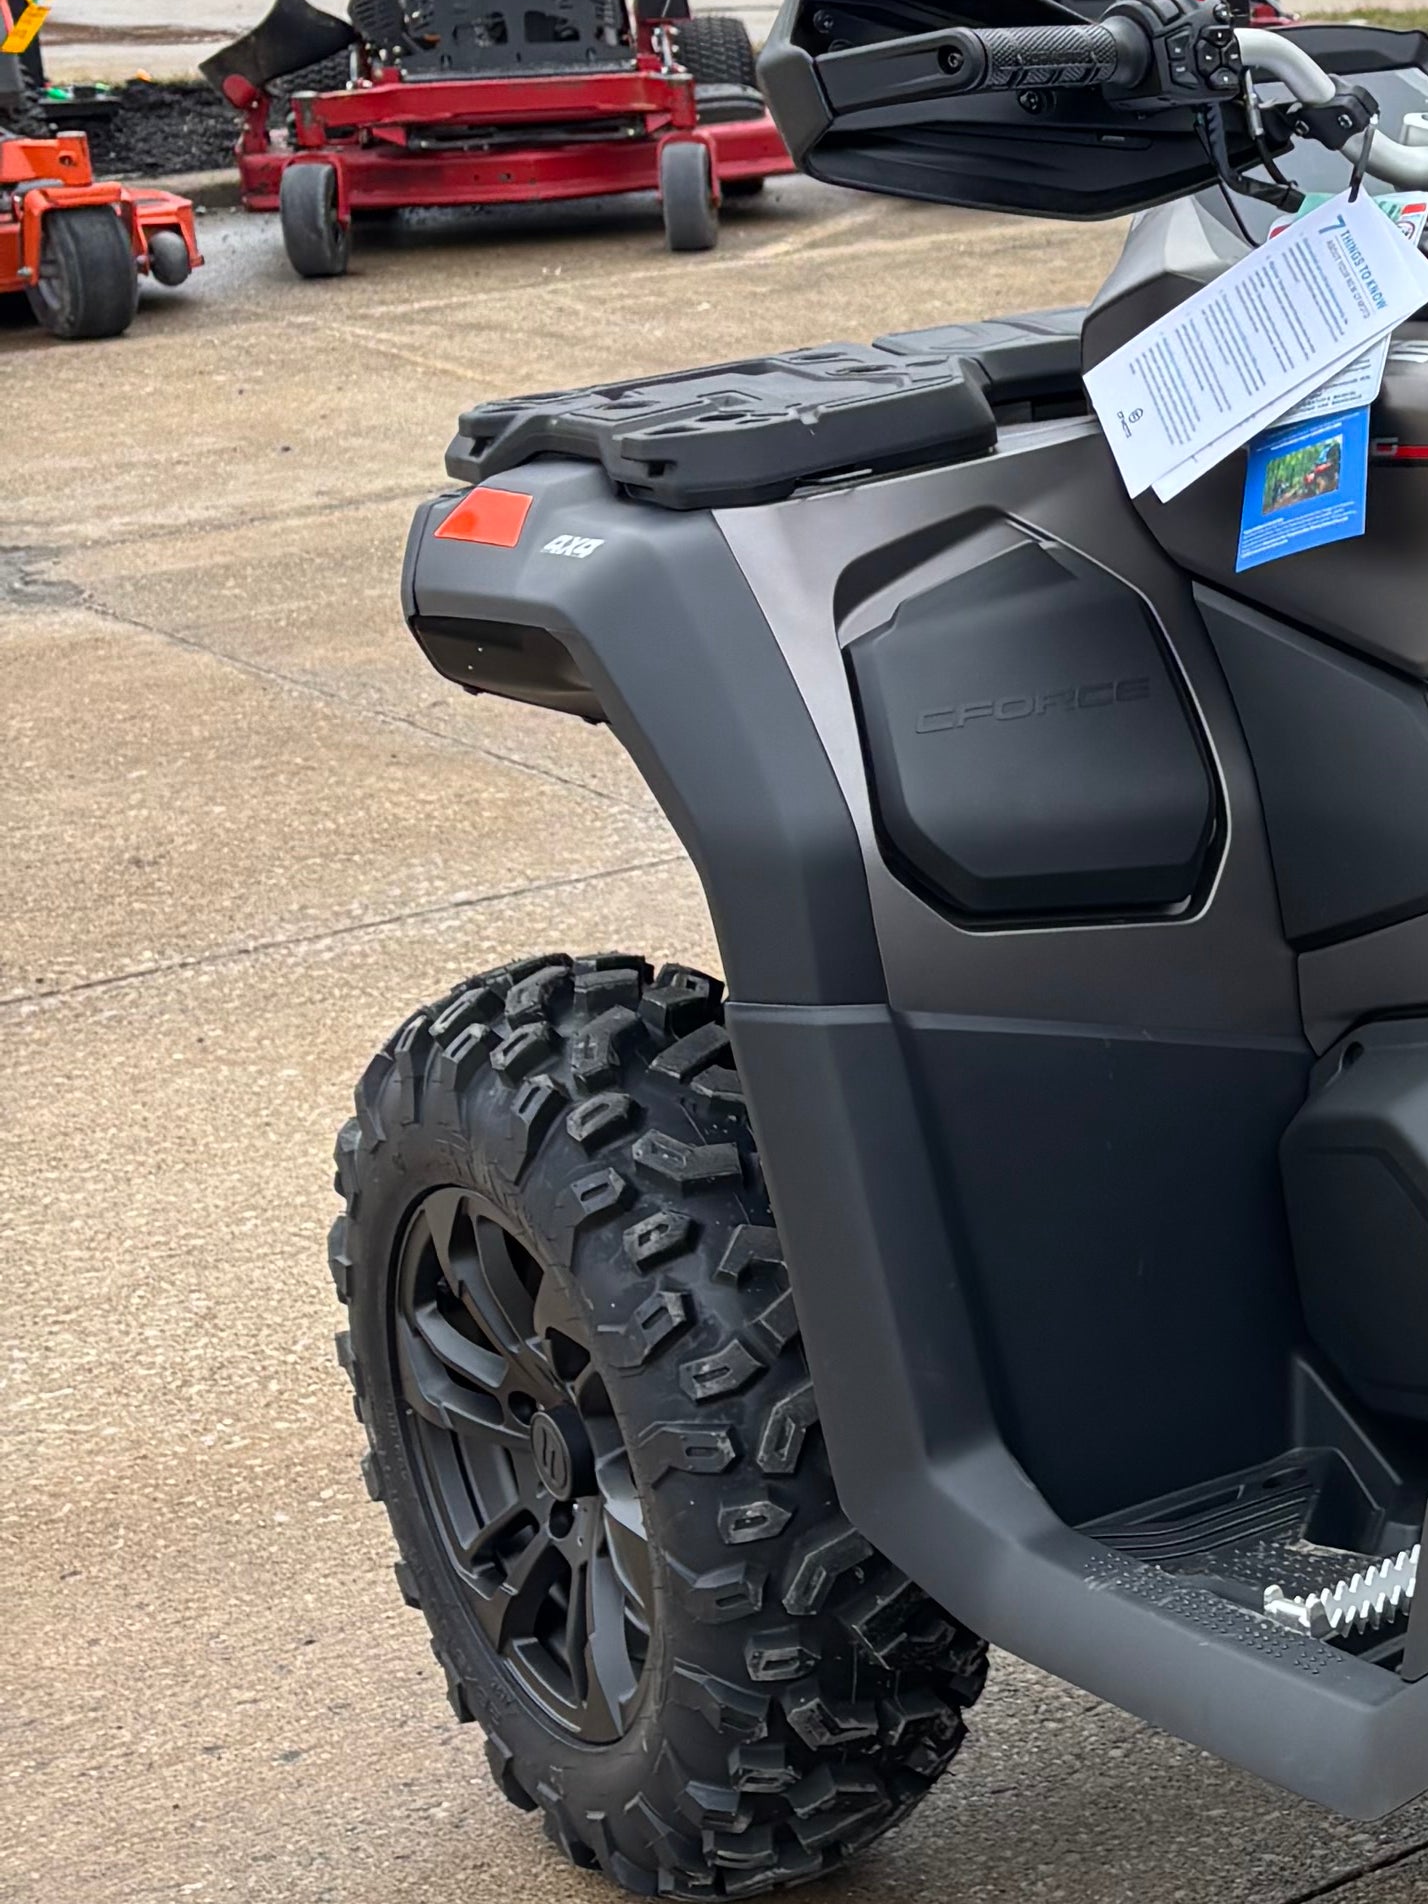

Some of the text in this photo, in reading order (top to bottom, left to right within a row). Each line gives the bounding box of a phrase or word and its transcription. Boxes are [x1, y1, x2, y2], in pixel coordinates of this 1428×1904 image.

[1318, 214, 1388, 310] 7 THINGS TO KNOW
[915, 677, 1151, 734] CFORCE
